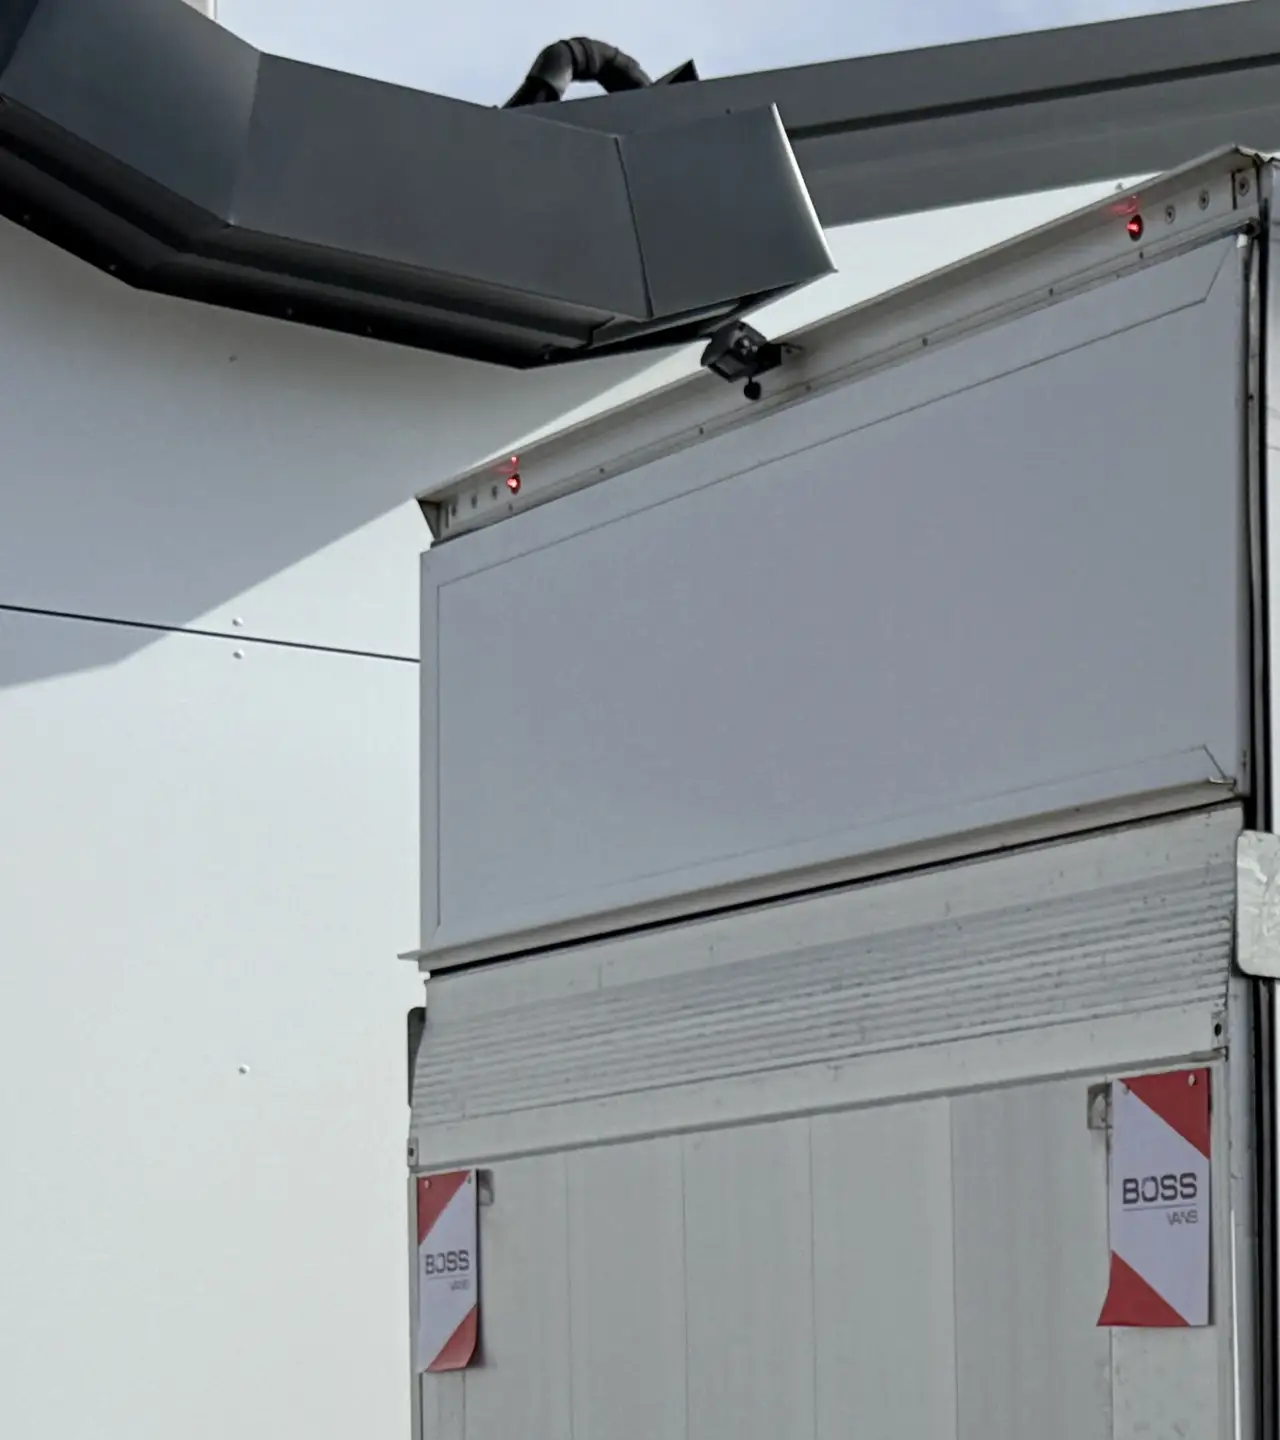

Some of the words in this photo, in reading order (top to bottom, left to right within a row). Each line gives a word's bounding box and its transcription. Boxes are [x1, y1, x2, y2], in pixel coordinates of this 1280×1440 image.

[1122, 1172, 1198, 1205] BOSS
[1166, 1209, 1199, 1226] VANS
[425, 1249, 470, 1275] BOSS
